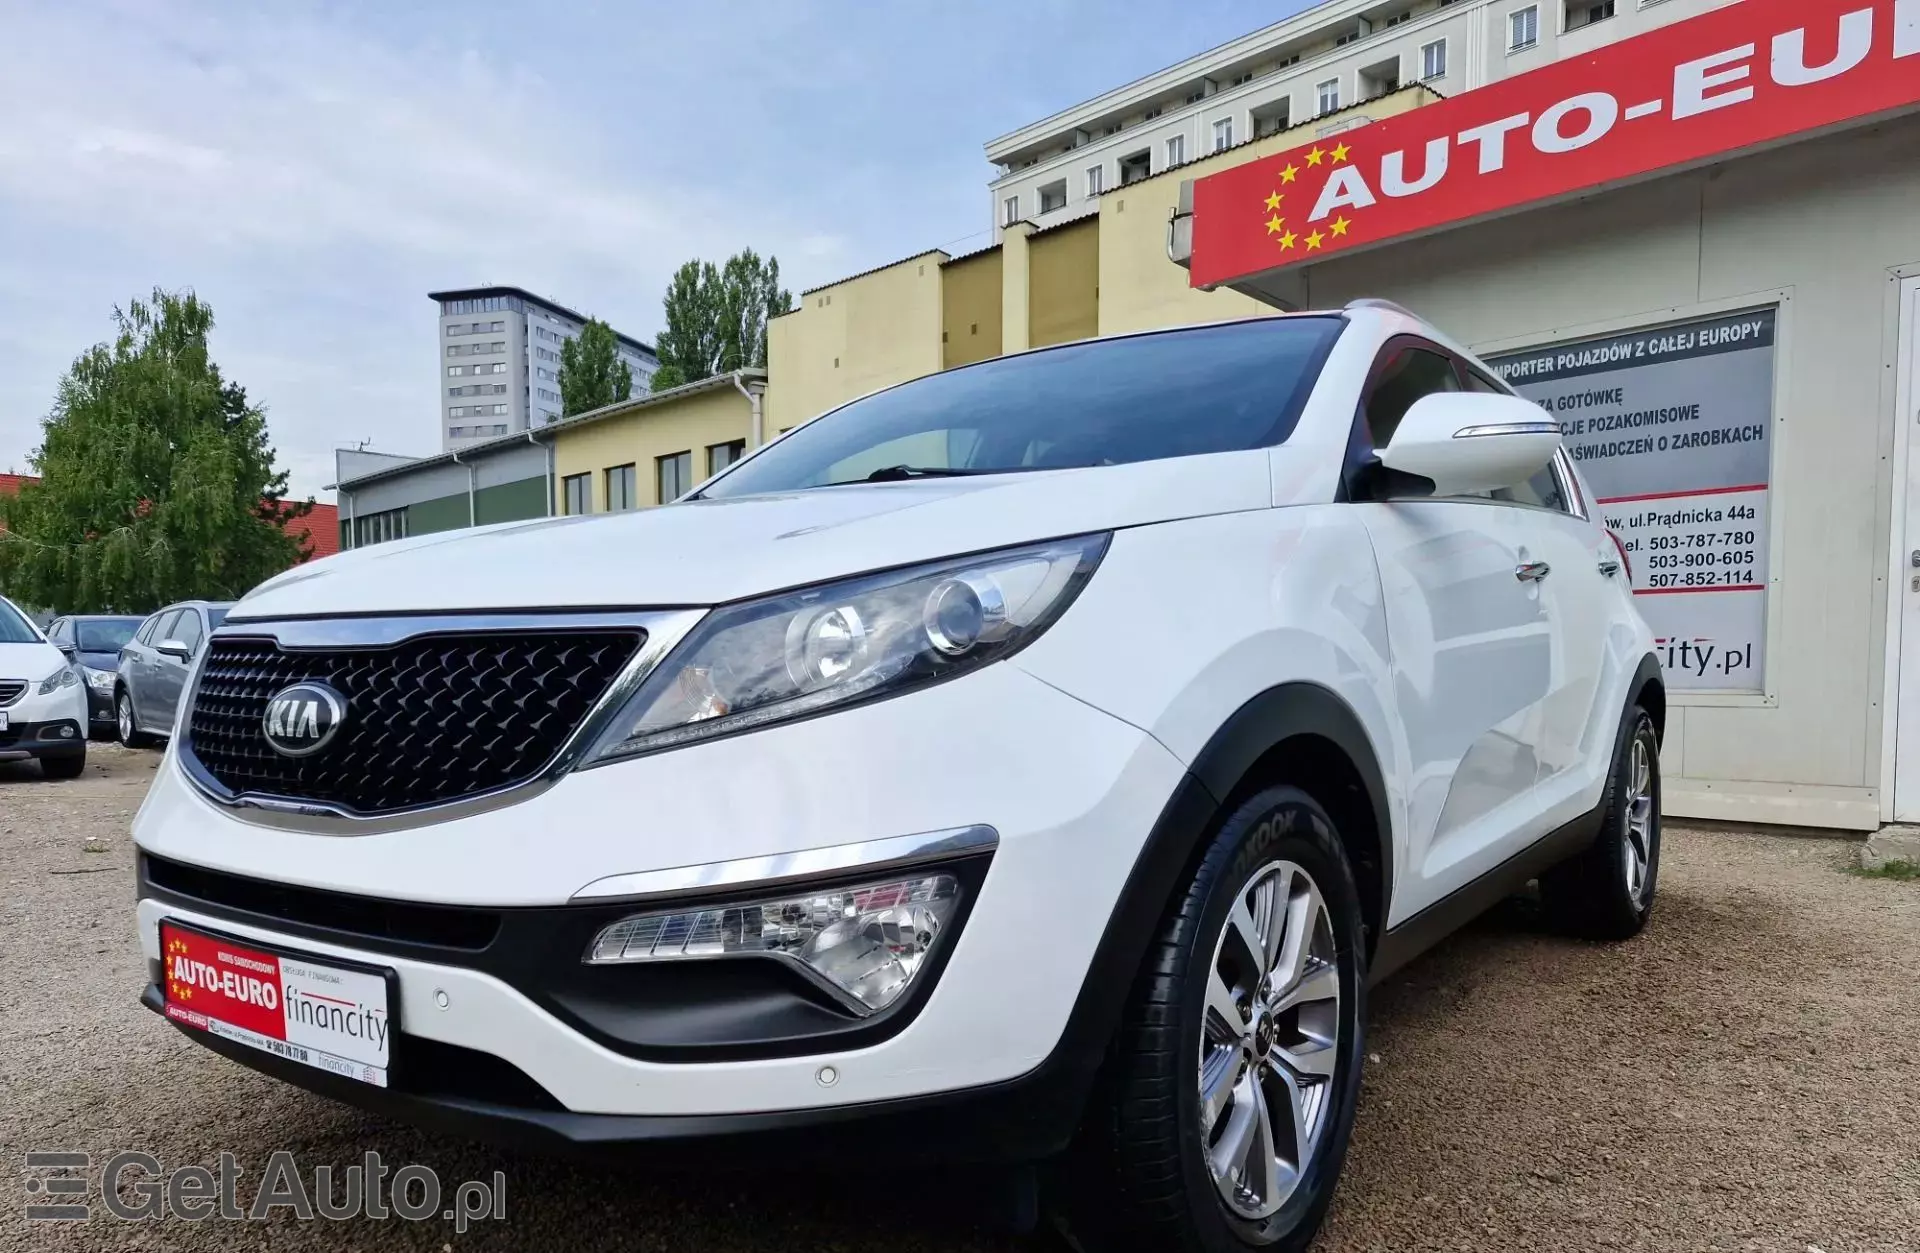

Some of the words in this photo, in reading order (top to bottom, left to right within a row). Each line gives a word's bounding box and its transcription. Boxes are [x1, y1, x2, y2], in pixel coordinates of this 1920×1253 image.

[1489, 357, 1554, 379] MPORTER
[1557, 342, 1632, 370] POJAZDÓW
[1635, 341, 1645, 358] Z
[1648, 335, 1695, 356] CAŁEJ
[1699, 320, 1763, 347] EUROPY
[1557, 387, 1624, 411] GOTÓWKĘ
[1560, 420, 1585, 436] CJE
[1588, 404, 1701, 433] POZAKOMISOWE
[1657, 436, 1668, 452] O
[1671, 424, 1764, 450] ZAROBKACH
[1629, 508, 1723, 530] ul.Prądnicka
[1727, 505, 1756, 521] 44a
[1624, 538, 1644, 552] el.
[1650, 530, 1755, 550] 503-787-780
[1649, 550, 1755, 569] 503-900-605
[1649, 569, 1754, 587] 507-852-114
[268, 700, 320, 738] KIA
[174, 955, 278, 1010] AUTO-EURO
[285, 984, 389, 1051] financity
